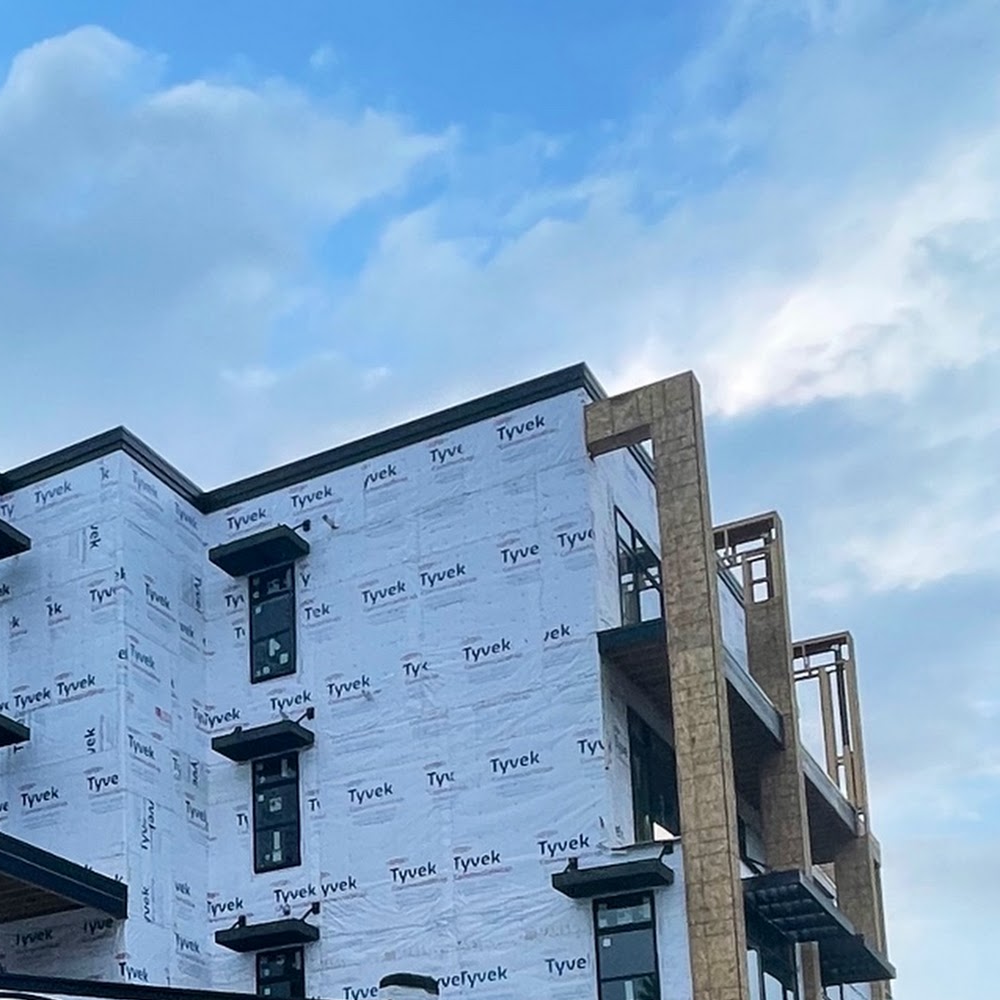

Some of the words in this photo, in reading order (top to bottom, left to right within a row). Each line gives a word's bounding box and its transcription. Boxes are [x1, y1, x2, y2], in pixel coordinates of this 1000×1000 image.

[497, 415, 546, 440] Tyvek
[35, 481, 72, 504] Tyvek
[291, 486, 332, 508] Tyvek
[227, 508, 266, 530] Tyvek
[420, 563, 466, 586] Tyvek
[362, 580, 407, 604] Tyvek
[463, 638, 511, 662] Tyvek
[57, 673, 96, 696] Tyvek
[327, 675, 371, 698] Tyvek
[14, 687, 51, 711] Tyvek
[270, 690, 312, 710] Tyvek
[490, 750, 540, 774] Tyvek
[21, 786, 60, 808] Tyvek
[348, 782, 394, 803] Tyvek
[538, 833, 590, 859] Tyvek
[390, 862, 437, 884] Tyvek
[453, 850, 501, 873] Tyvek
[274, 884, 317, 903] Tyvek
